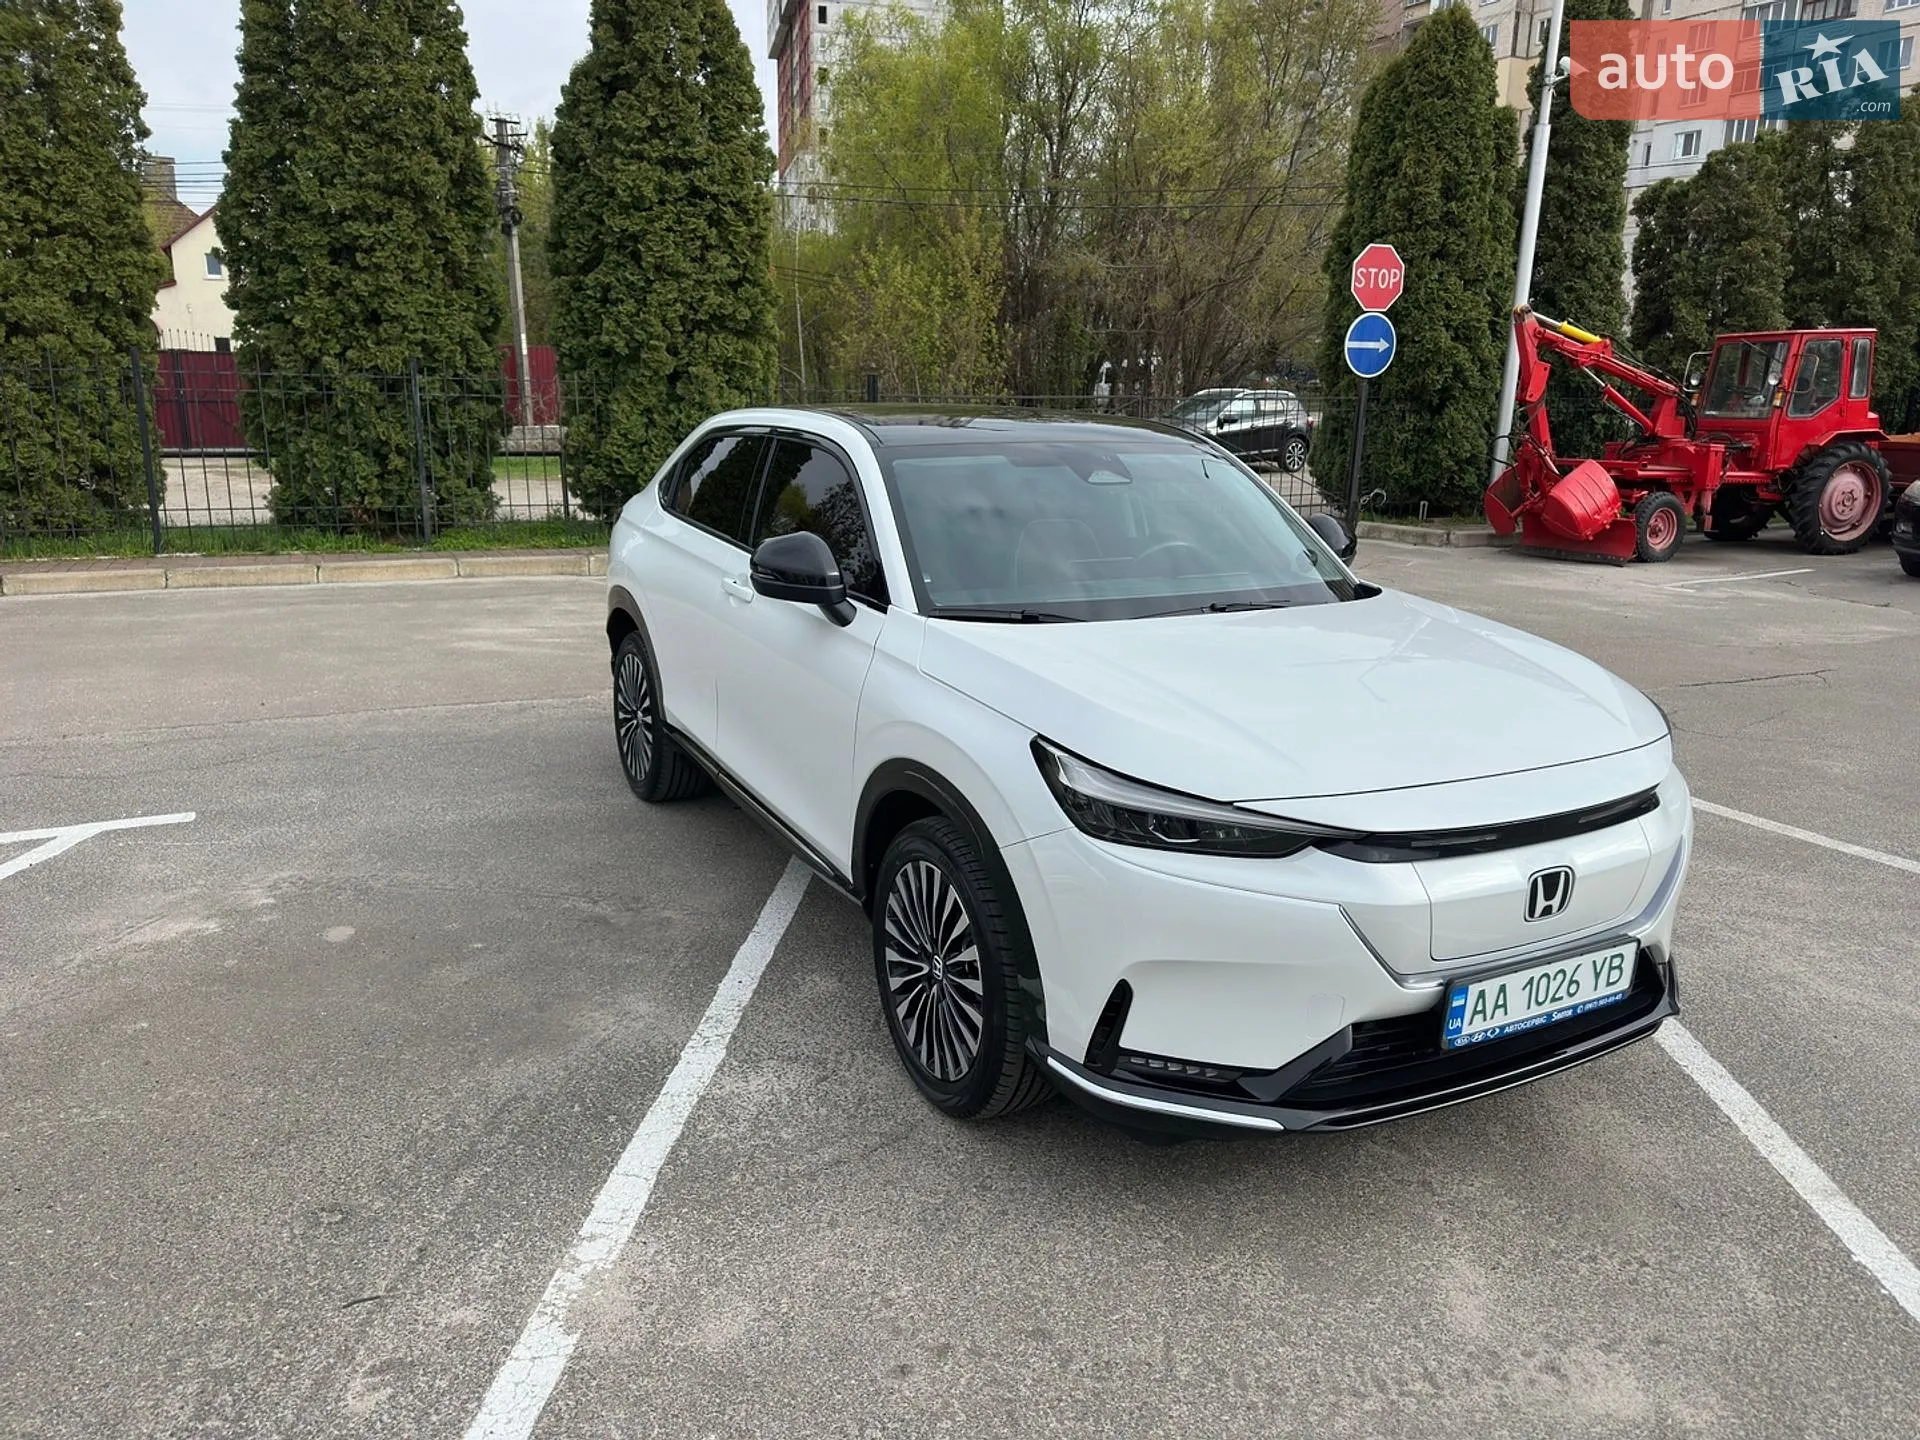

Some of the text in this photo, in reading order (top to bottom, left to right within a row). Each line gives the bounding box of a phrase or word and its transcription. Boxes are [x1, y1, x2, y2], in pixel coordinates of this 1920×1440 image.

[1355, 267, 1400, 289] STOP
[1468, 983, 1509, 1026] AA
[1522, 963, 1583, 1011] 1026
[1592, 953, 1625, 992] YB
[1448, 1017, 1463, 1030] UA
